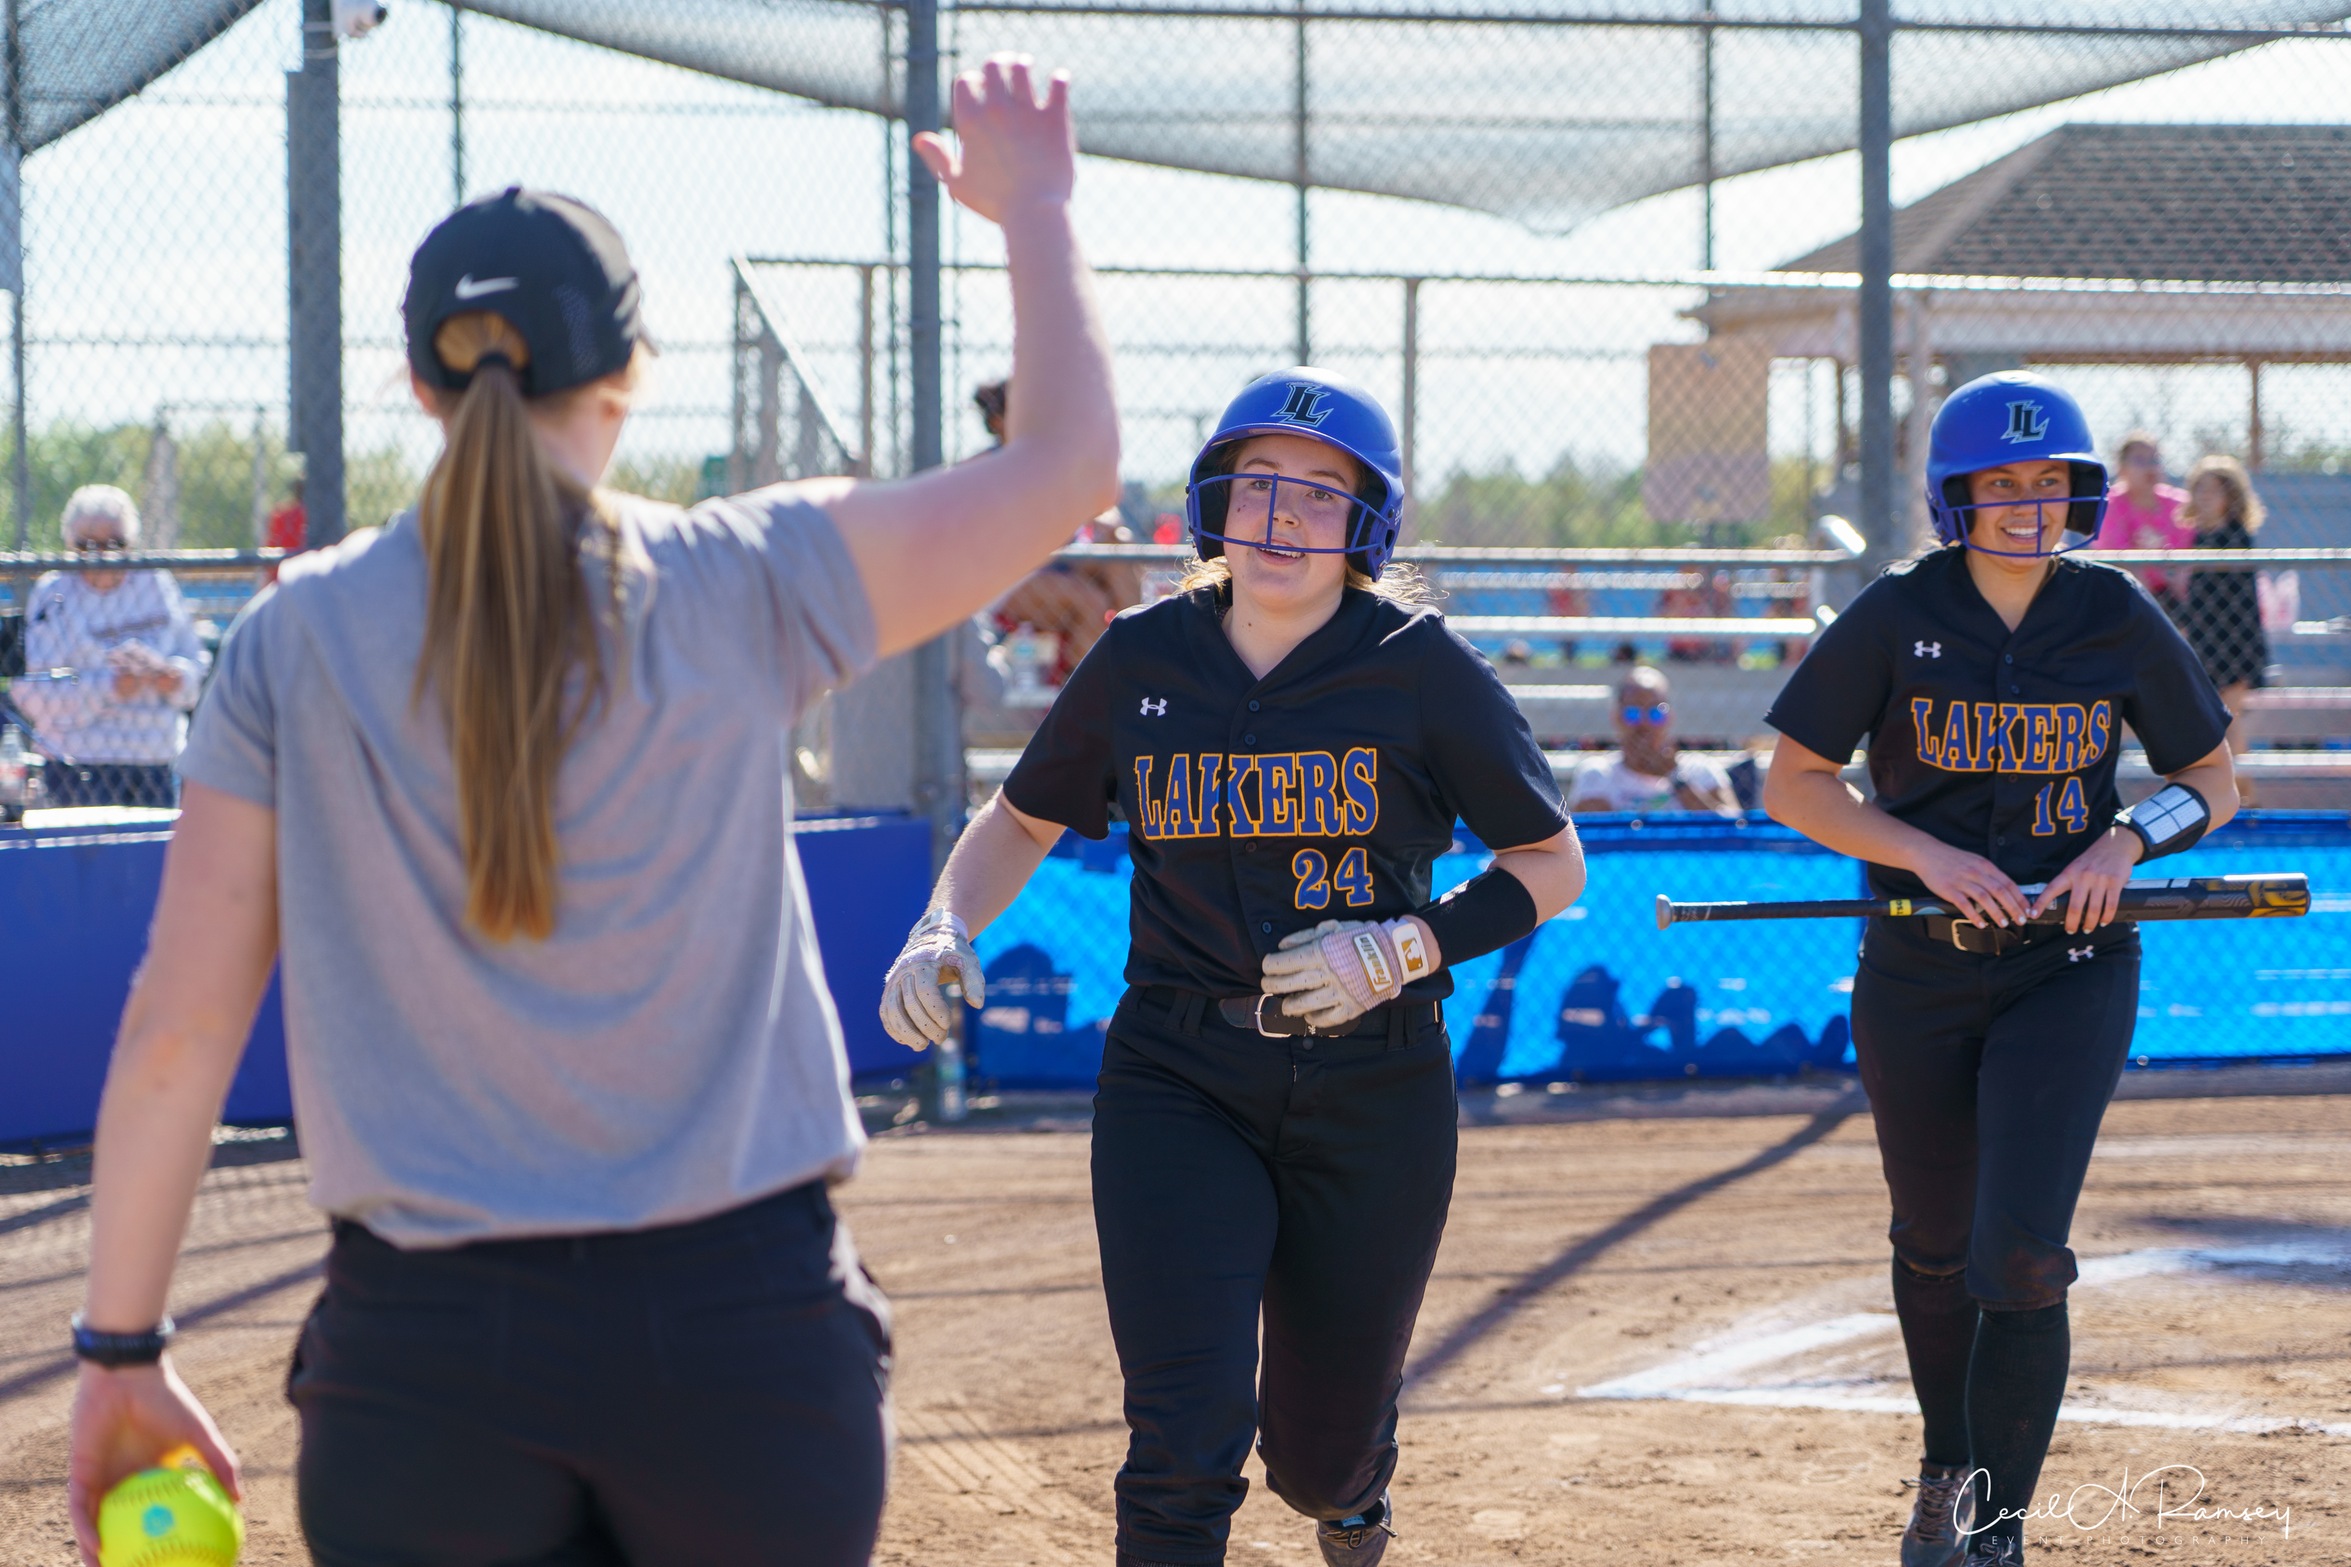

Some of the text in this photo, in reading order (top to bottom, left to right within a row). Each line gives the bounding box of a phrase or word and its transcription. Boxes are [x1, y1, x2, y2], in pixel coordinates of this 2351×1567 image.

[1910, 698, 2111, 774] LAKERS
[1133, 747, 1379, 840] LAKERS
[2032, 776, 2088, 837] 14
[1292, 848, 1374, 910] 24
